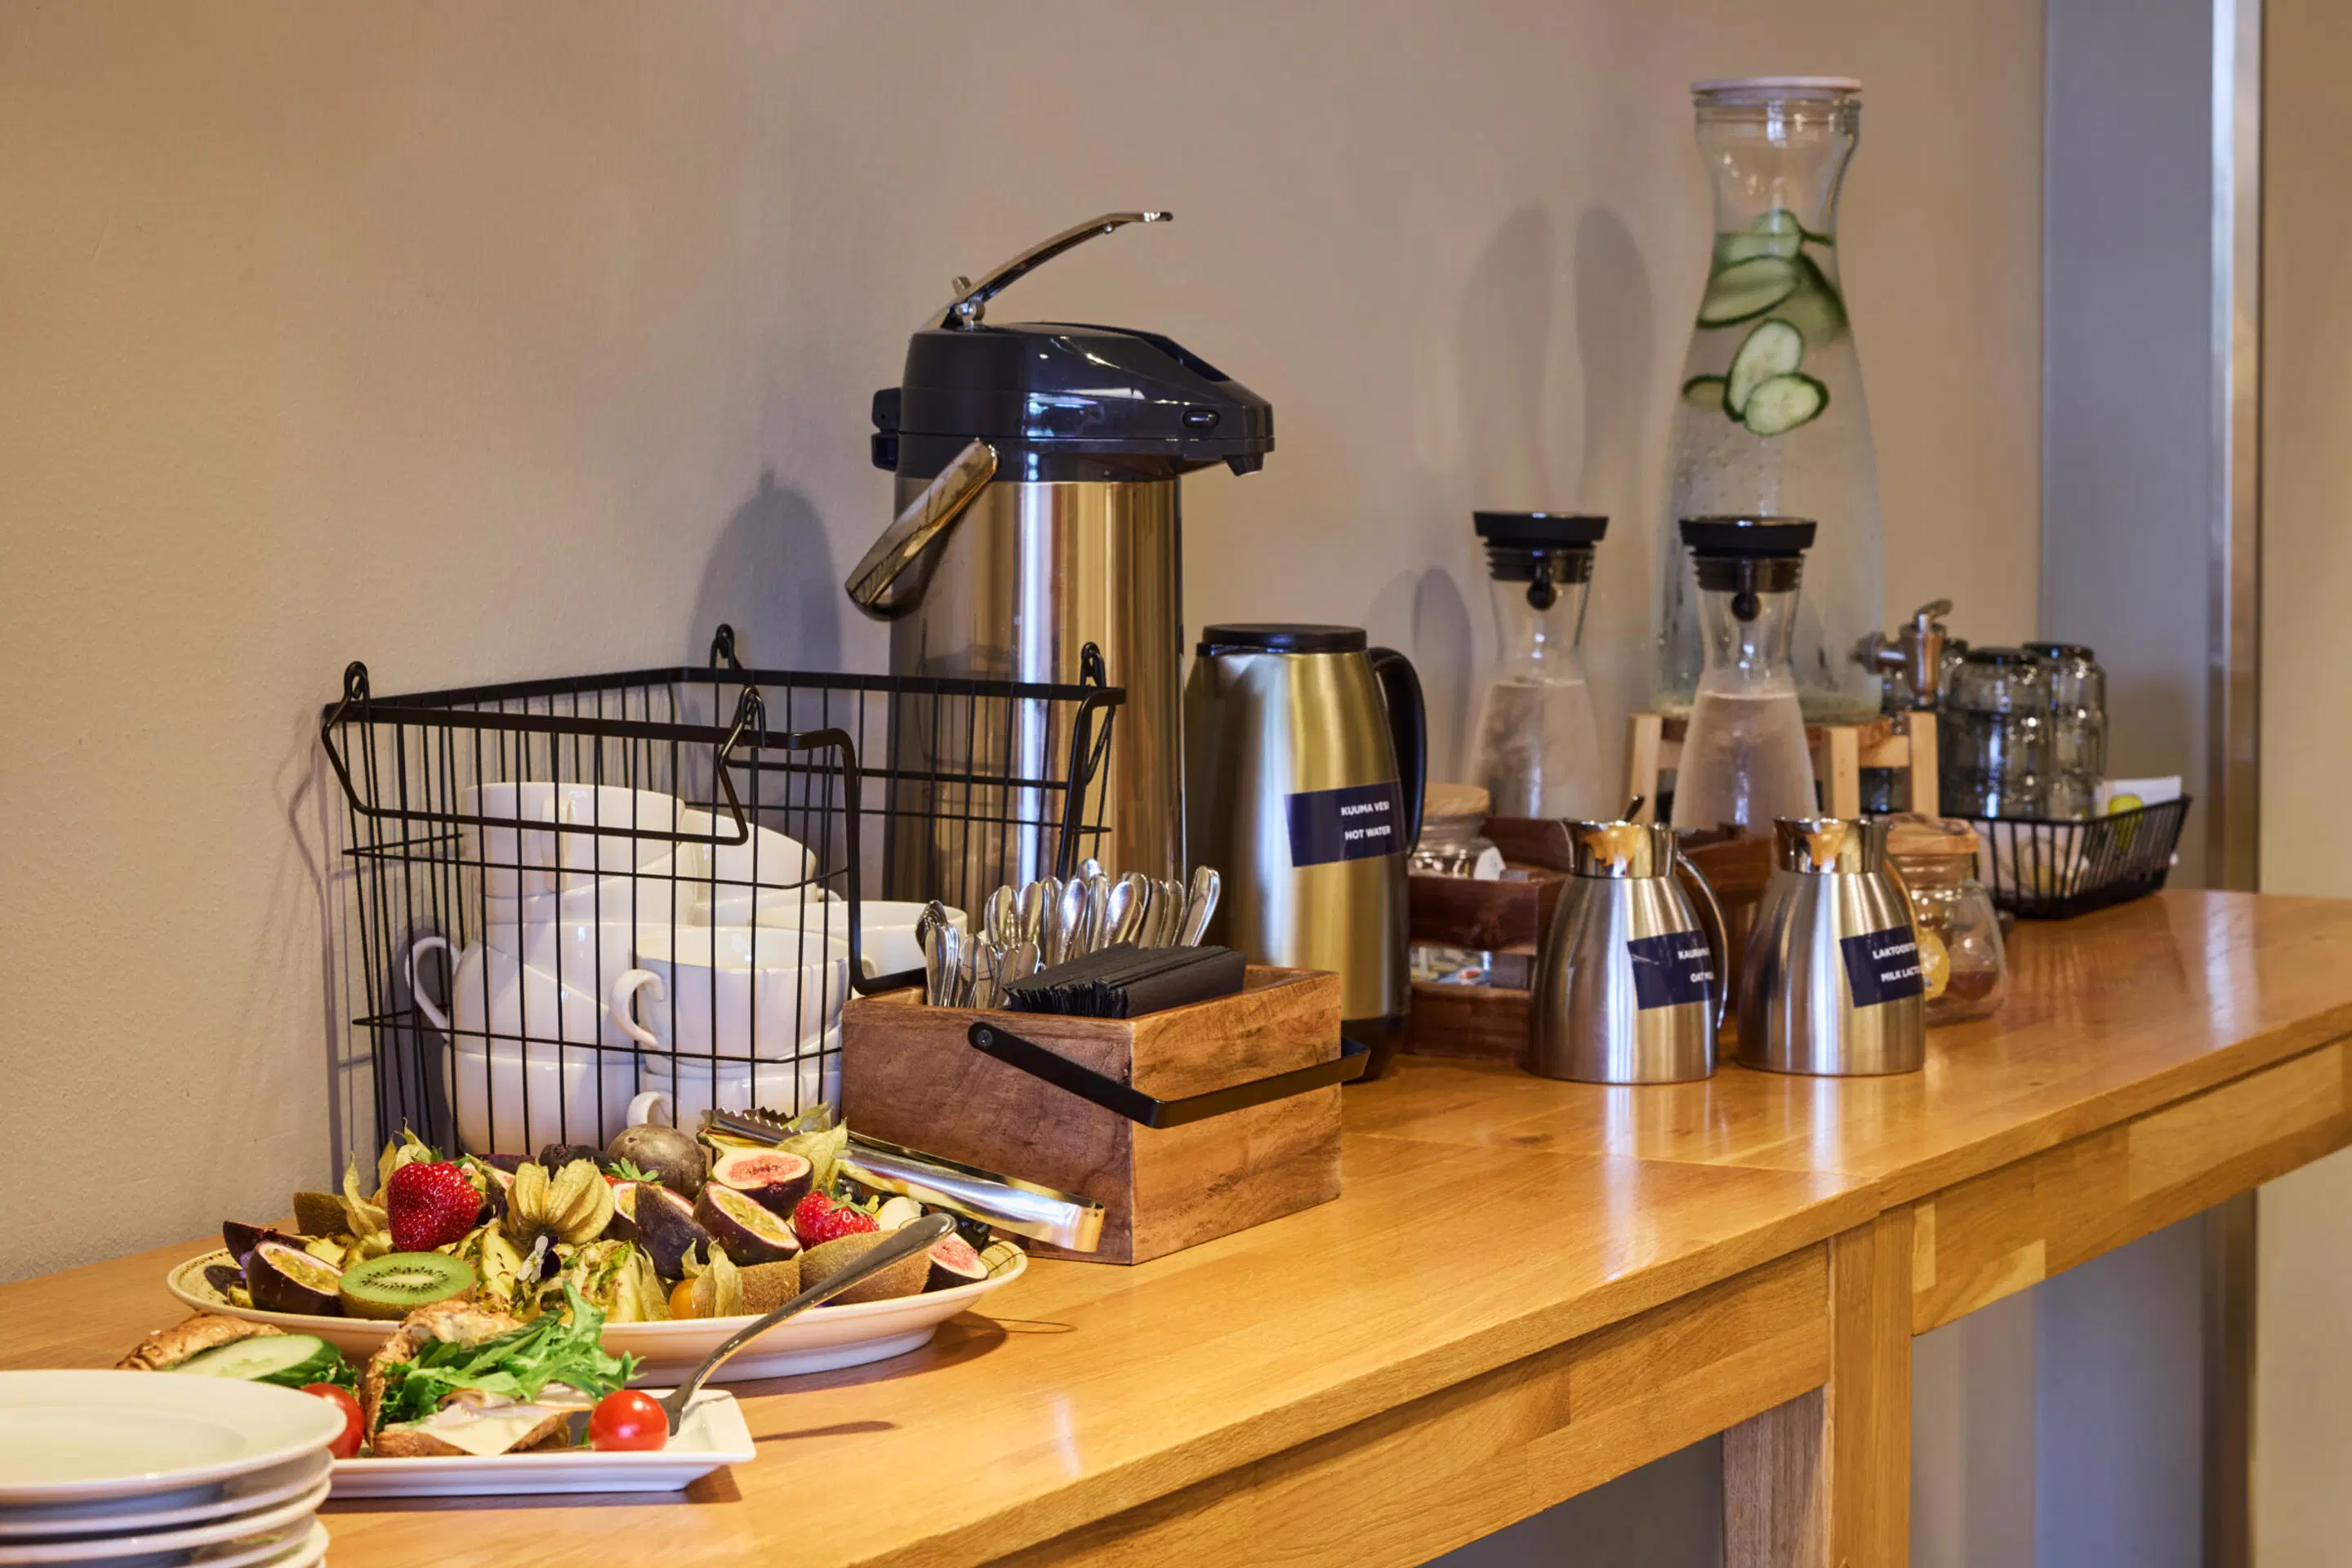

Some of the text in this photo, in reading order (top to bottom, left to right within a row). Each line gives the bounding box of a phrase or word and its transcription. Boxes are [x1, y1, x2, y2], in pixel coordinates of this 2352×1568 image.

[1340, 803, 1374, 816] KUUMA
[1344, 825, 1392, 840] HOT WATER
[1881, 970, 1902, 982] MILK
